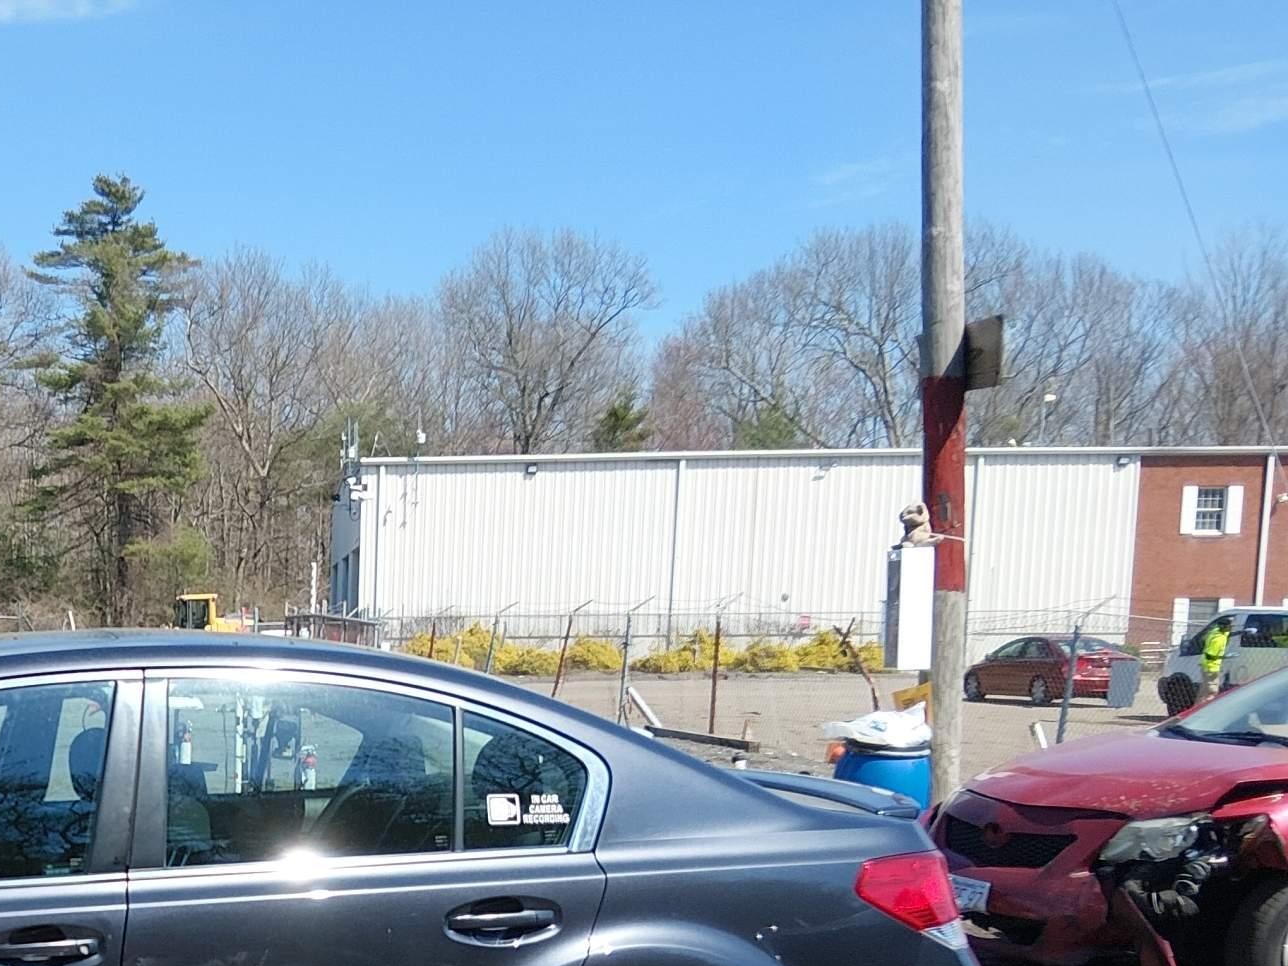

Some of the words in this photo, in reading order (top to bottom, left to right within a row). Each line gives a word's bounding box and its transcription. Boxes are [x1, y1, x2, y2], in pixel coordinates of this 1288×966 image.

[531, 794, 540, 803] IN
[541, 794, 559, 803] CAR
[529, 804, 564, 813] CAMERA
[522, 813, 570, 824] RECORDING
